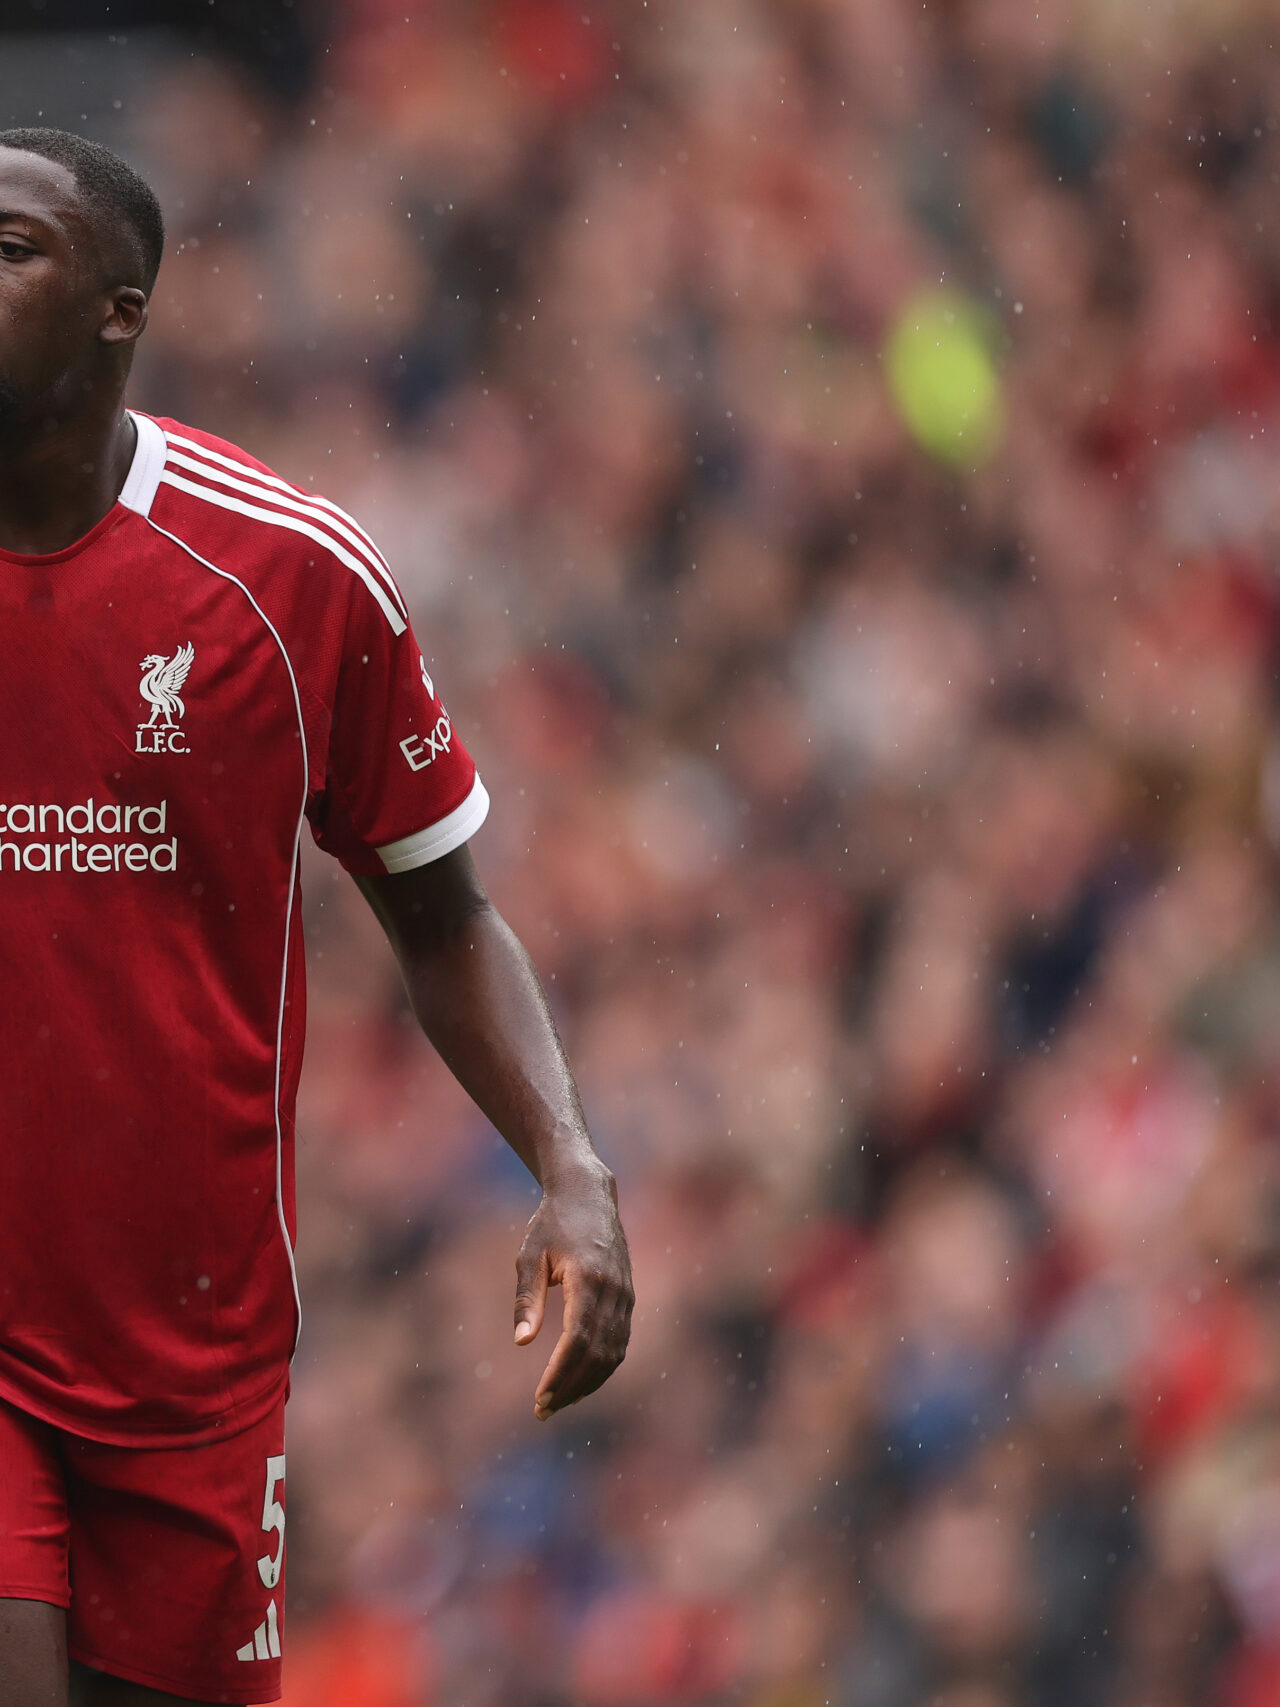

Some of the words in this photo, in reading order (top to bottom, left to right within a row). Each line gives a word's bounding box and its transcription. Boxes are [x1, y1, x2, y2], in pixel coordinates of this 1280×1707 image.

[135, 731, 191, 753] L.F.C.
[399, 703, 451, 771] Exp
[257, 1454, 286, 1589] 5
